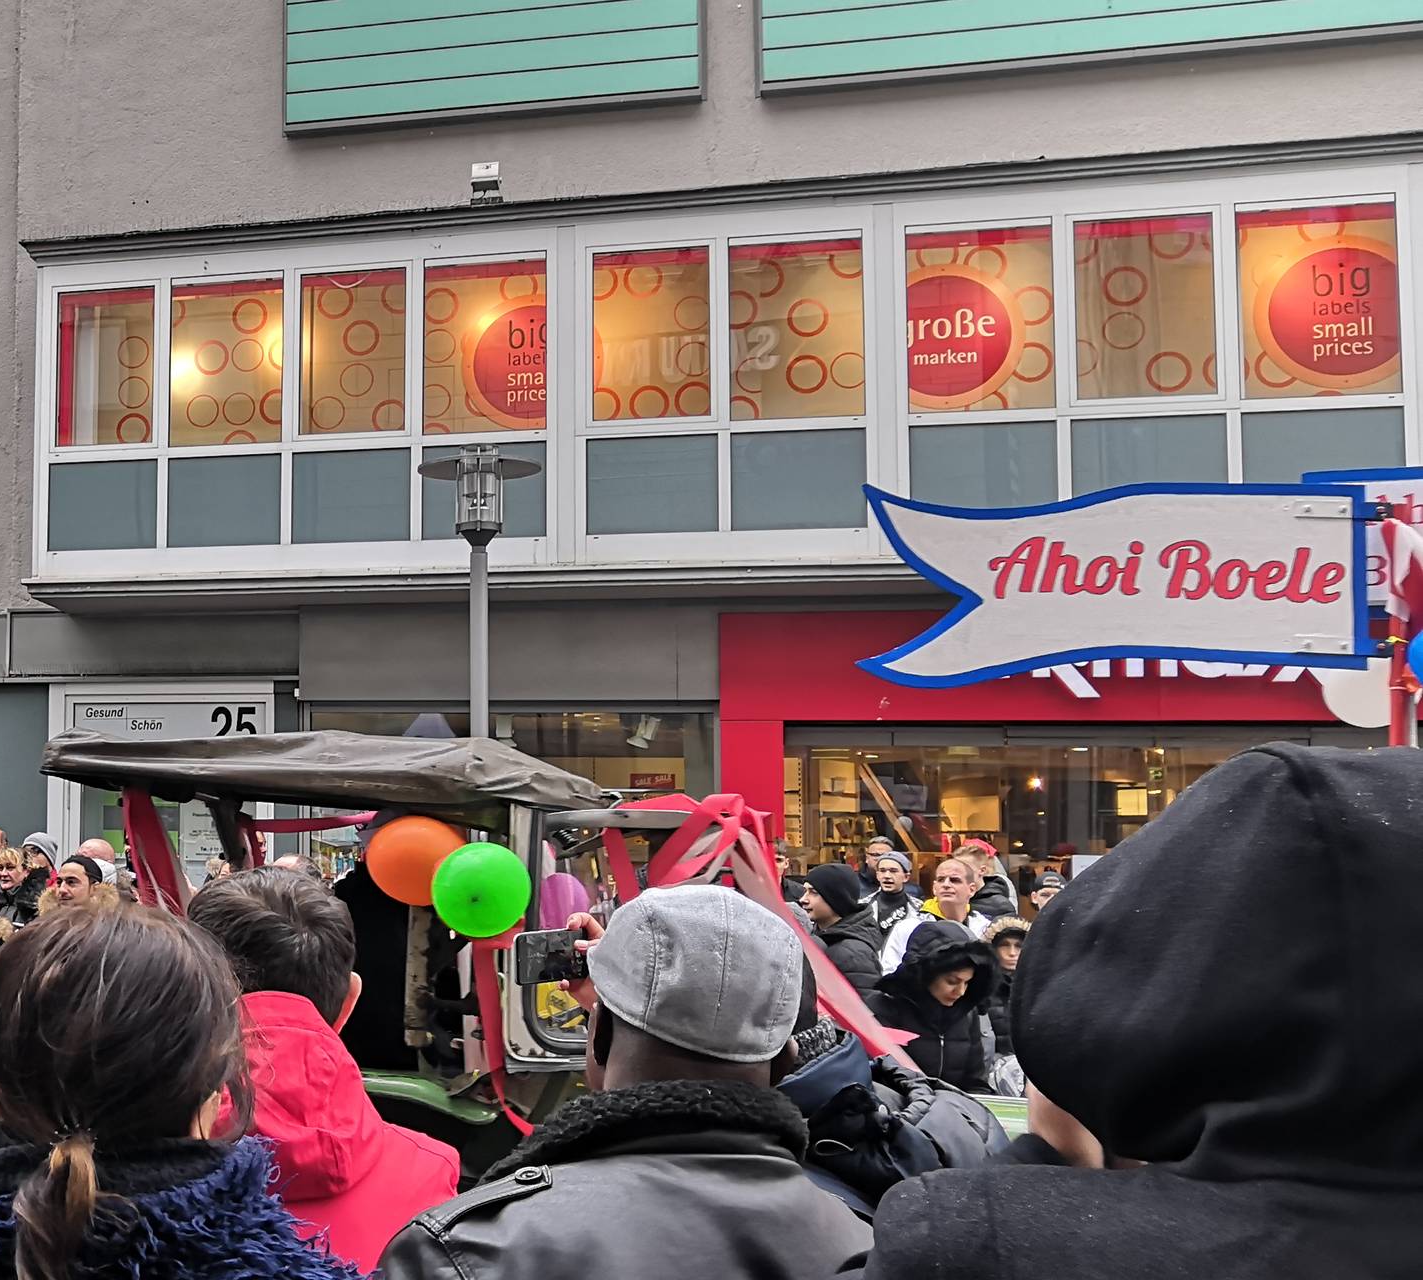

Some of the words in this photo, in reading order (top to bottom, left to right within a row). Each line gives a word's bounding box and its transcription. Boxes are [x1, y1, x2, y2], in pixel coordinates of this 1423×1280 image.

[1312, 262, 1371, 297] big
[1313, 299, 1371, 316] labels
[1312, 316, 1374, 339] small
[507, 351, 546, 366] label
[913, 348, 978, 366] marken
[1313, 338, 1374, 362] prices
[507, 370, 544, 386] sma
[507, 386, 547, 407] price
[989, 536, 1145, 600] Ahoi
[1159, 540, 1347, 604] Boele
[85, 707, 124, 718] Gesund
[211, 706, 257, 737] 25
[130, 719, 163, 731] Schön
